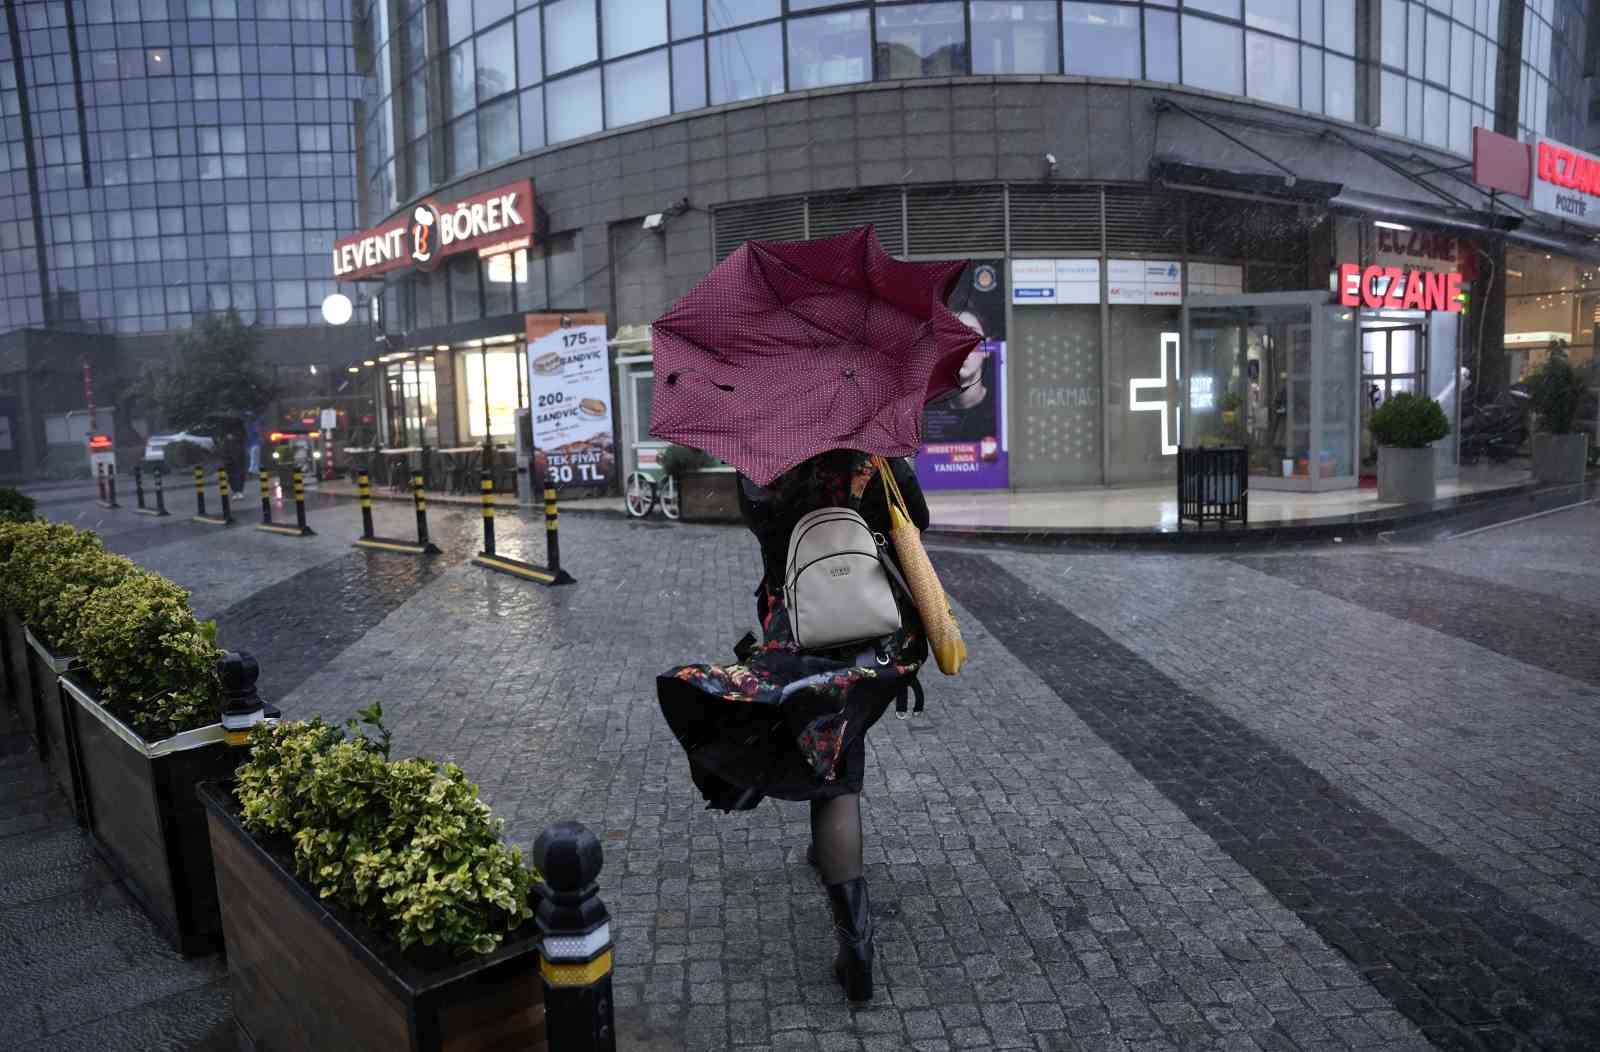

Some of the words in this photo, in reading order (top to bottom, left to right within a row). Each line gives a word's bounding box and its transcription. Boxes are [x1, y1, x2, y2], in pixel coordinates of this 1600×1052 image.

[332, 228, 407, 276] LEVENT
[441, 192, 525, 245] BÖREK
[1339, 263, 1463, 313] ECZANE
[562, 332, 588, 348] 175
[538, 391, 564, 408] 200
[578, 463, 605, 481] TL
